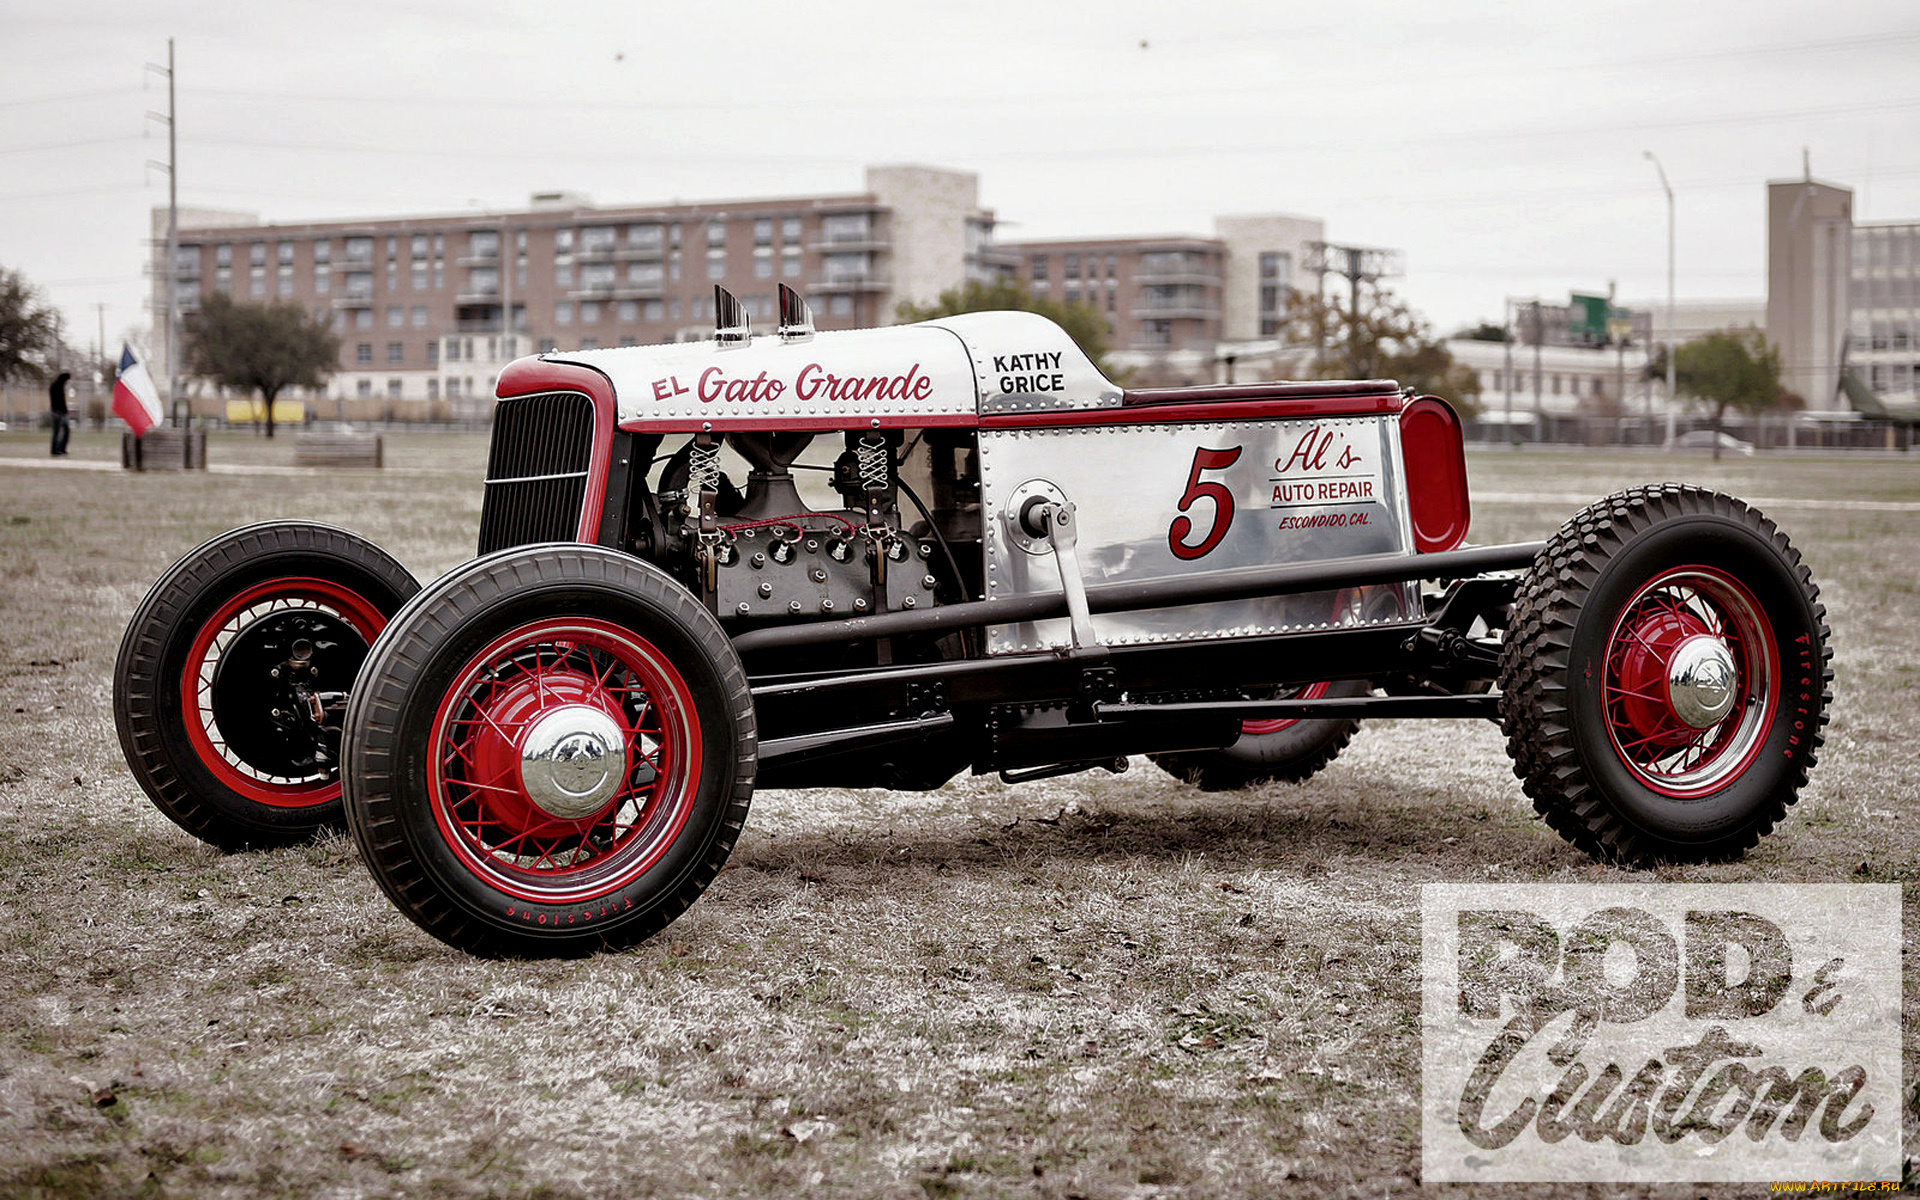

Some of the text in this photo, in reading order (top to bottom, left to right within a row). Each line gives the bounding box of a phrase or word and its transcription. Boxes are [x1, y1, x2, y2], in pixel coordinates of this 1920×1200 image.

[994, 351, 1062, 373] KATHY
[652, 363, 933, 404] EL Gato Grande
[999, 374, 1065, 394] GRICE
[1275, 425, 1362, 473] Al's
[1168, 445, 1243, 561] 5
[1272, 481, 1374, 502] AUTO REPAIR
